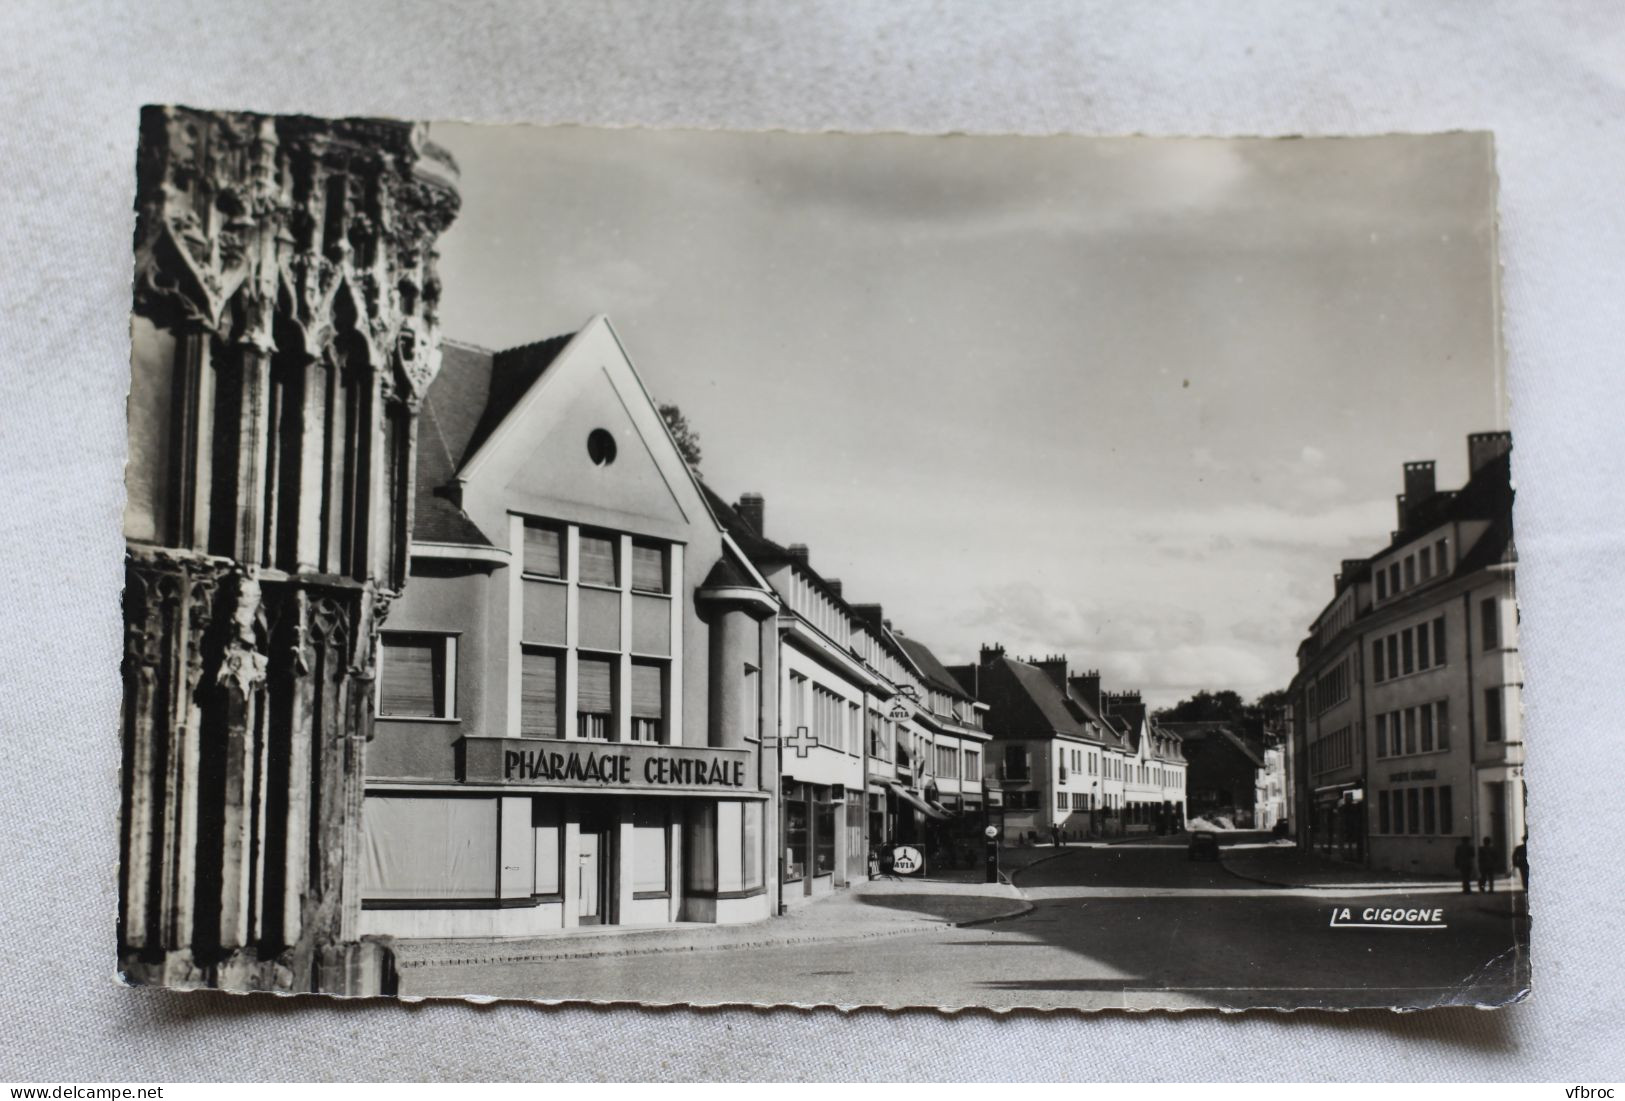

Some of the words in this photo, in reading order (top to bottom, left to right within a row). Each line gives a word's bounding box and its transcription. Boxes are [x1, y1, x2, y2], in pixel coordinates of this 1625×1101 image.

[504, 749, 631, 783] PHARMACIE
[644, 756, 745, 786] CENTRALE
[894, 861, 915, 869] AVIA
[1330, 908, 1351, 926] LA
[1362, 907, 1443, 922] CIGOGNE
